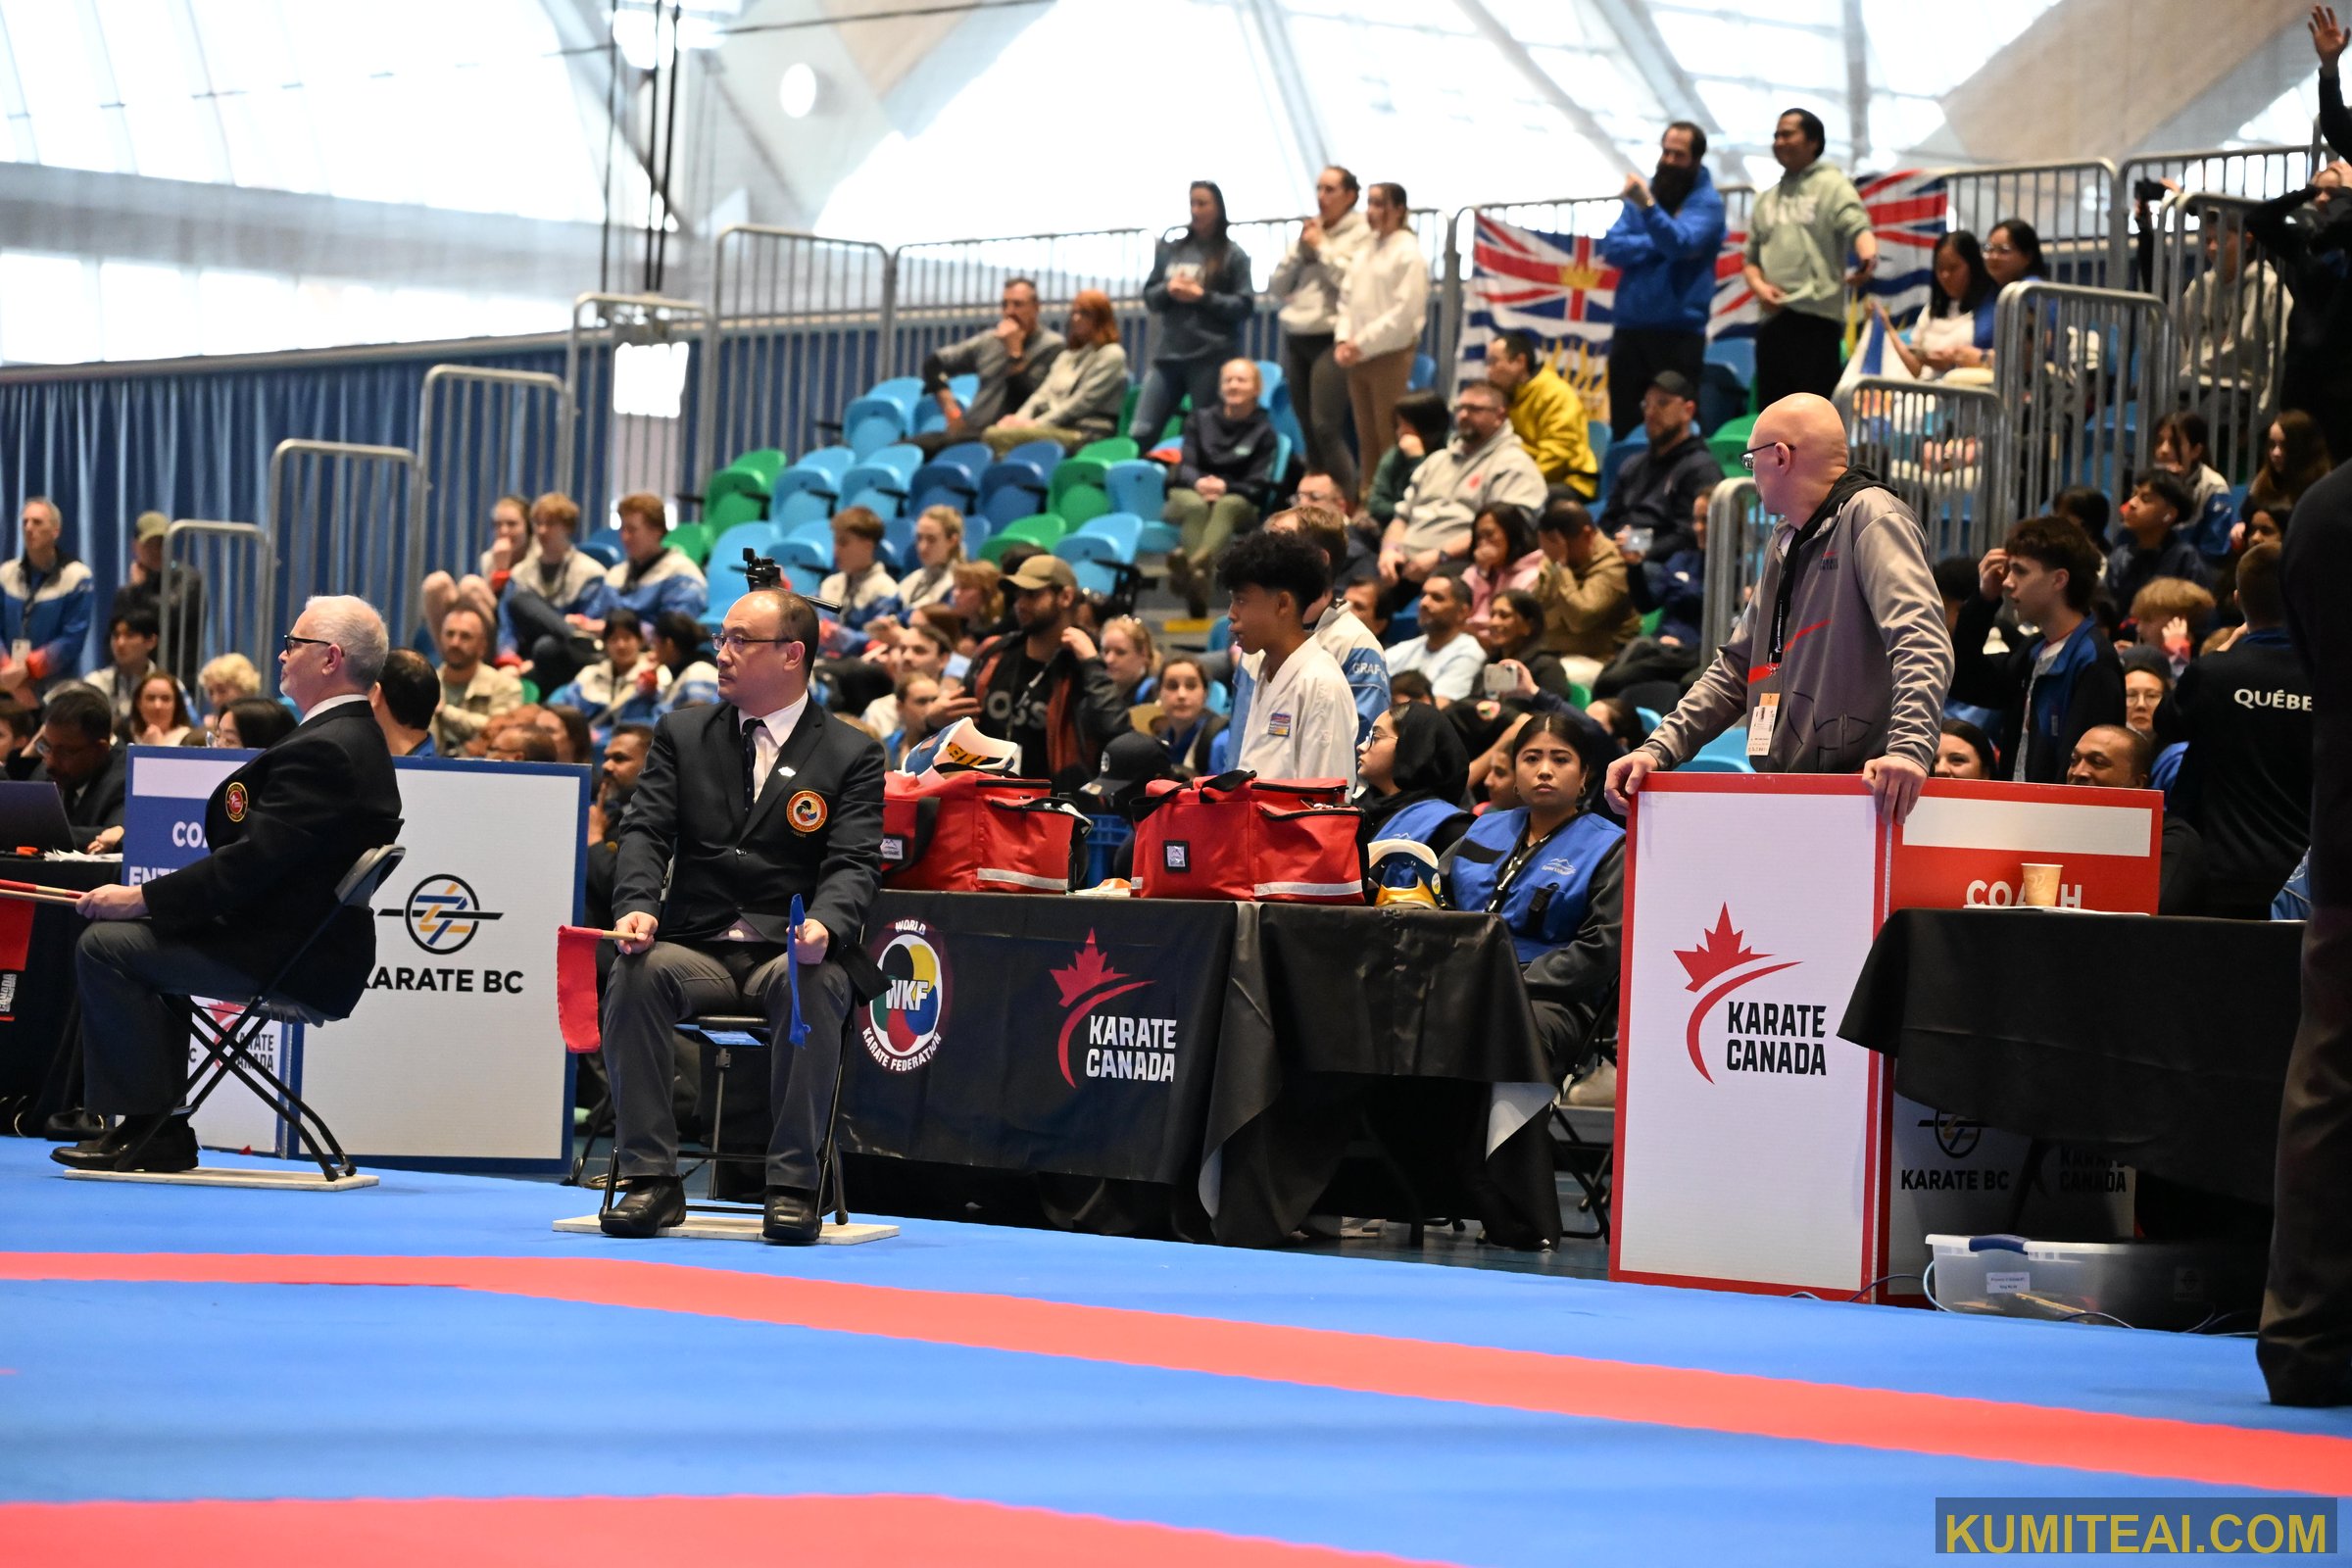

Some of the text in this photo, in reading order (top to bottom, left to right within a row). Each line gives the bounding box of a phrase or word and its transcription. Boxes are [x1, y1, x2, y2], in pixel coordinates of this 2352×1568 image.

[172, 820, 210, 849] CO
[1965, 879, 2082, 909] COH
[895, 919, 926, 935] WORLD
[365, 966, 524, 994] ARATE BC
[885, 979, 930, 1011] WKF
[1089, 1014, 1177, 1050] KARATE
[1728, 1001, 1827, 1038] KARATE
[862, 1026, 943, 1072] KARATE FEDERATION
[1726, 1039, 1827, 1076] CANADA
[1086, 1048, 1176, 1083] CANADA
[1900, 1169, 2009, 1191] KARATE BC
[2060, 1170, 2127, 1193] CANADA
